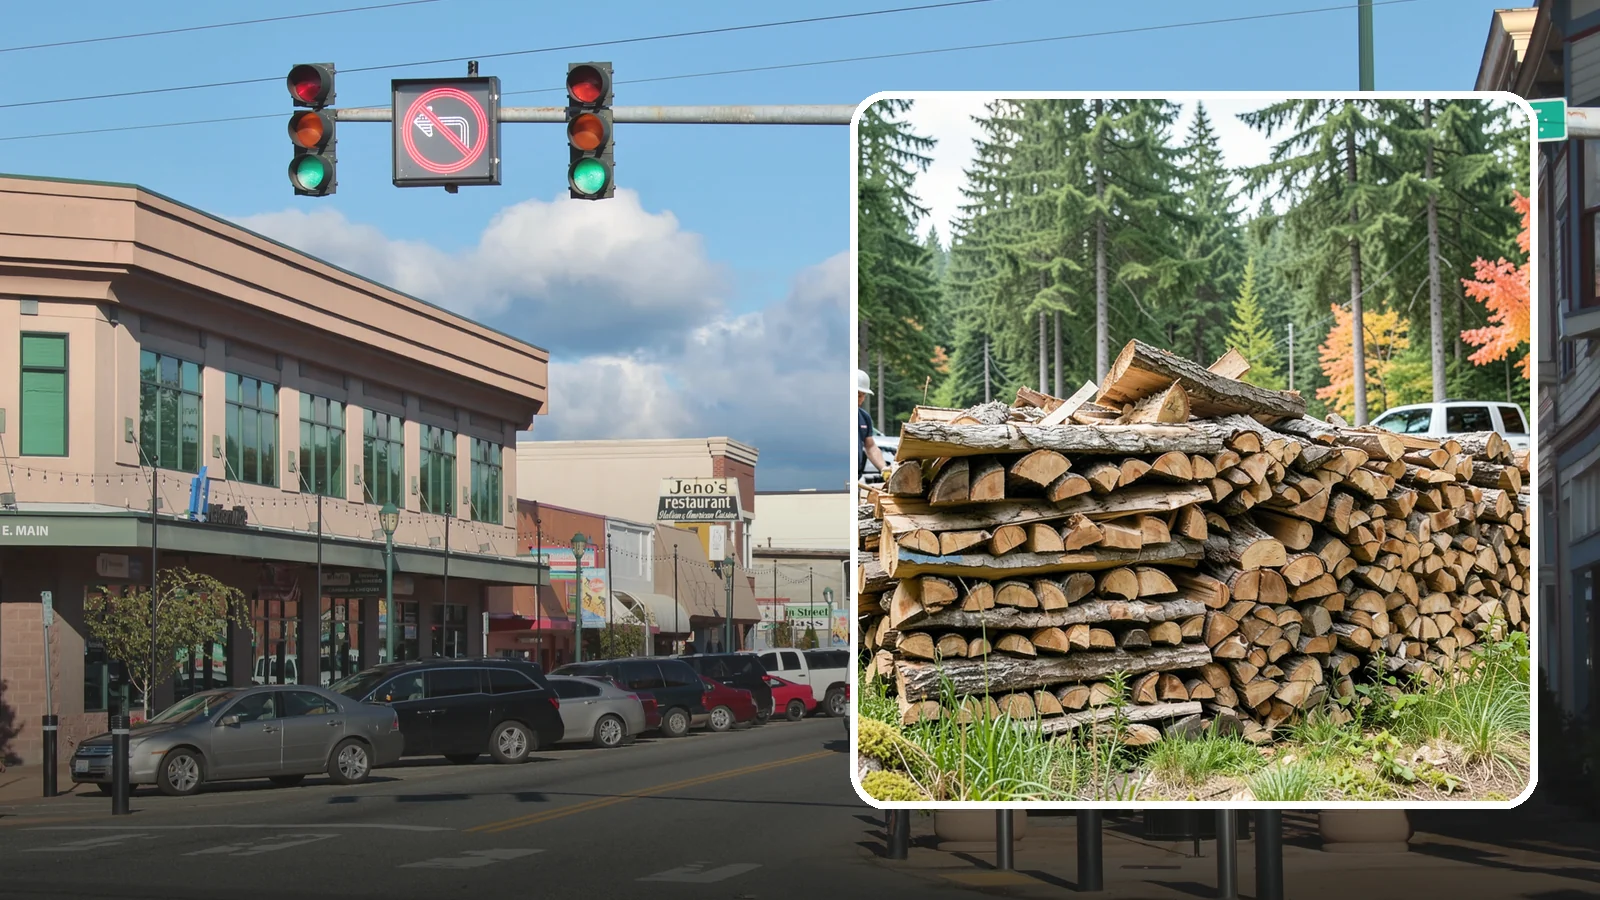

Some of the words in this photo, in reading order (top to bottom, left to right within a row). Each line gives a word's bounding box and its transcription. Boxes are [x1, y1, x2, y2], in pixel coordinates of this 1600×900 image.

[669, 479, 728, 495] Jeno's
[665, 496, 731, 509] restaurant
[658, 510, 682, 520] Italian
[686, 509, 715, 519] American
[715, 509, 738, 520] Cuisine
[2, 525, 13, 536] E.
[15, 525, 49, 536] MAIN
[797, 607, 829, 617] Street
[791, 619, 823, 627] lass
